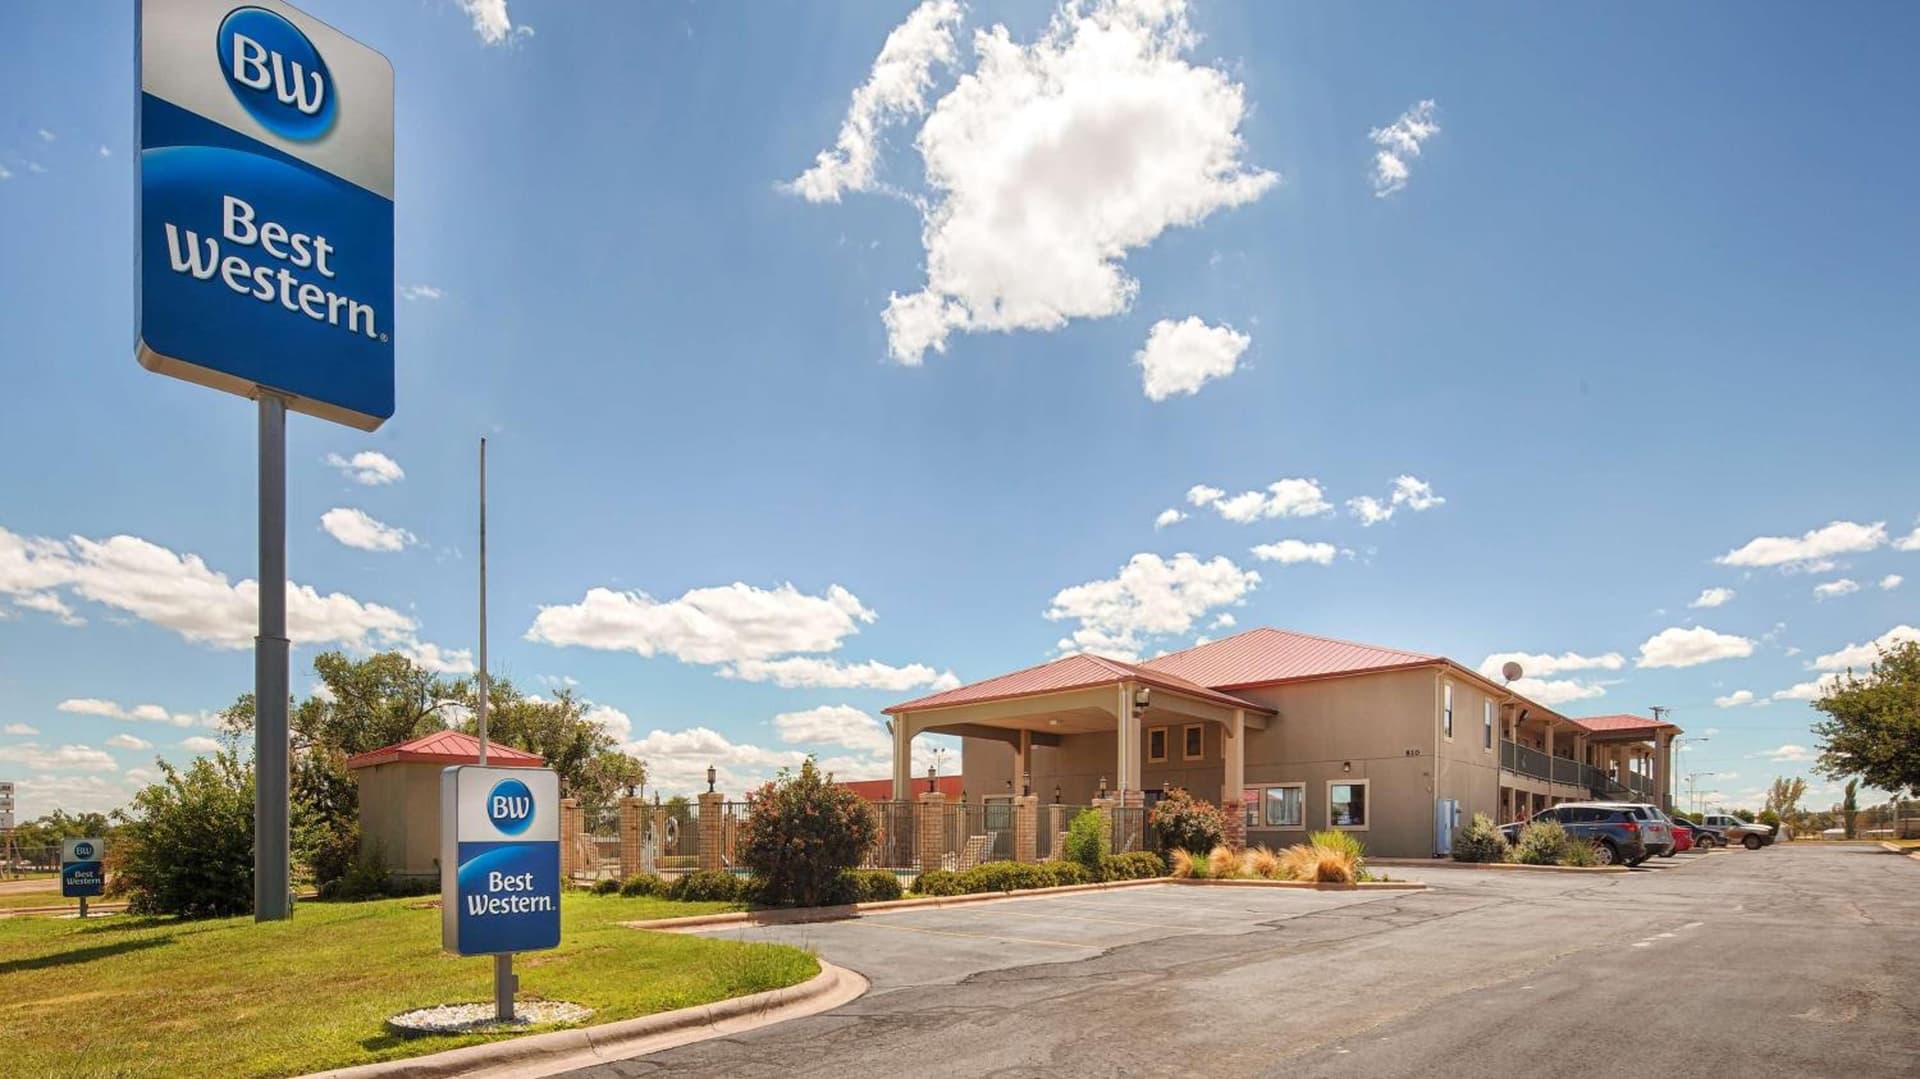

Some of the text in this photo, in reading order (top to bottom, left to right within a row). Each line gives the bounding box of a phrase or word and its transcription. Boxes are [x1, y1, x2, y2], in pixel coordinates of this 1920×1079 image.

[233, 32, 324, 115] BW
[223, 195, 334, 278] Best
[493, 795, 529, 819] BW
[67, 877, 101, 886] Western
[75, 870, 94, 878] Best
[489, 871, 534, 893] Best
